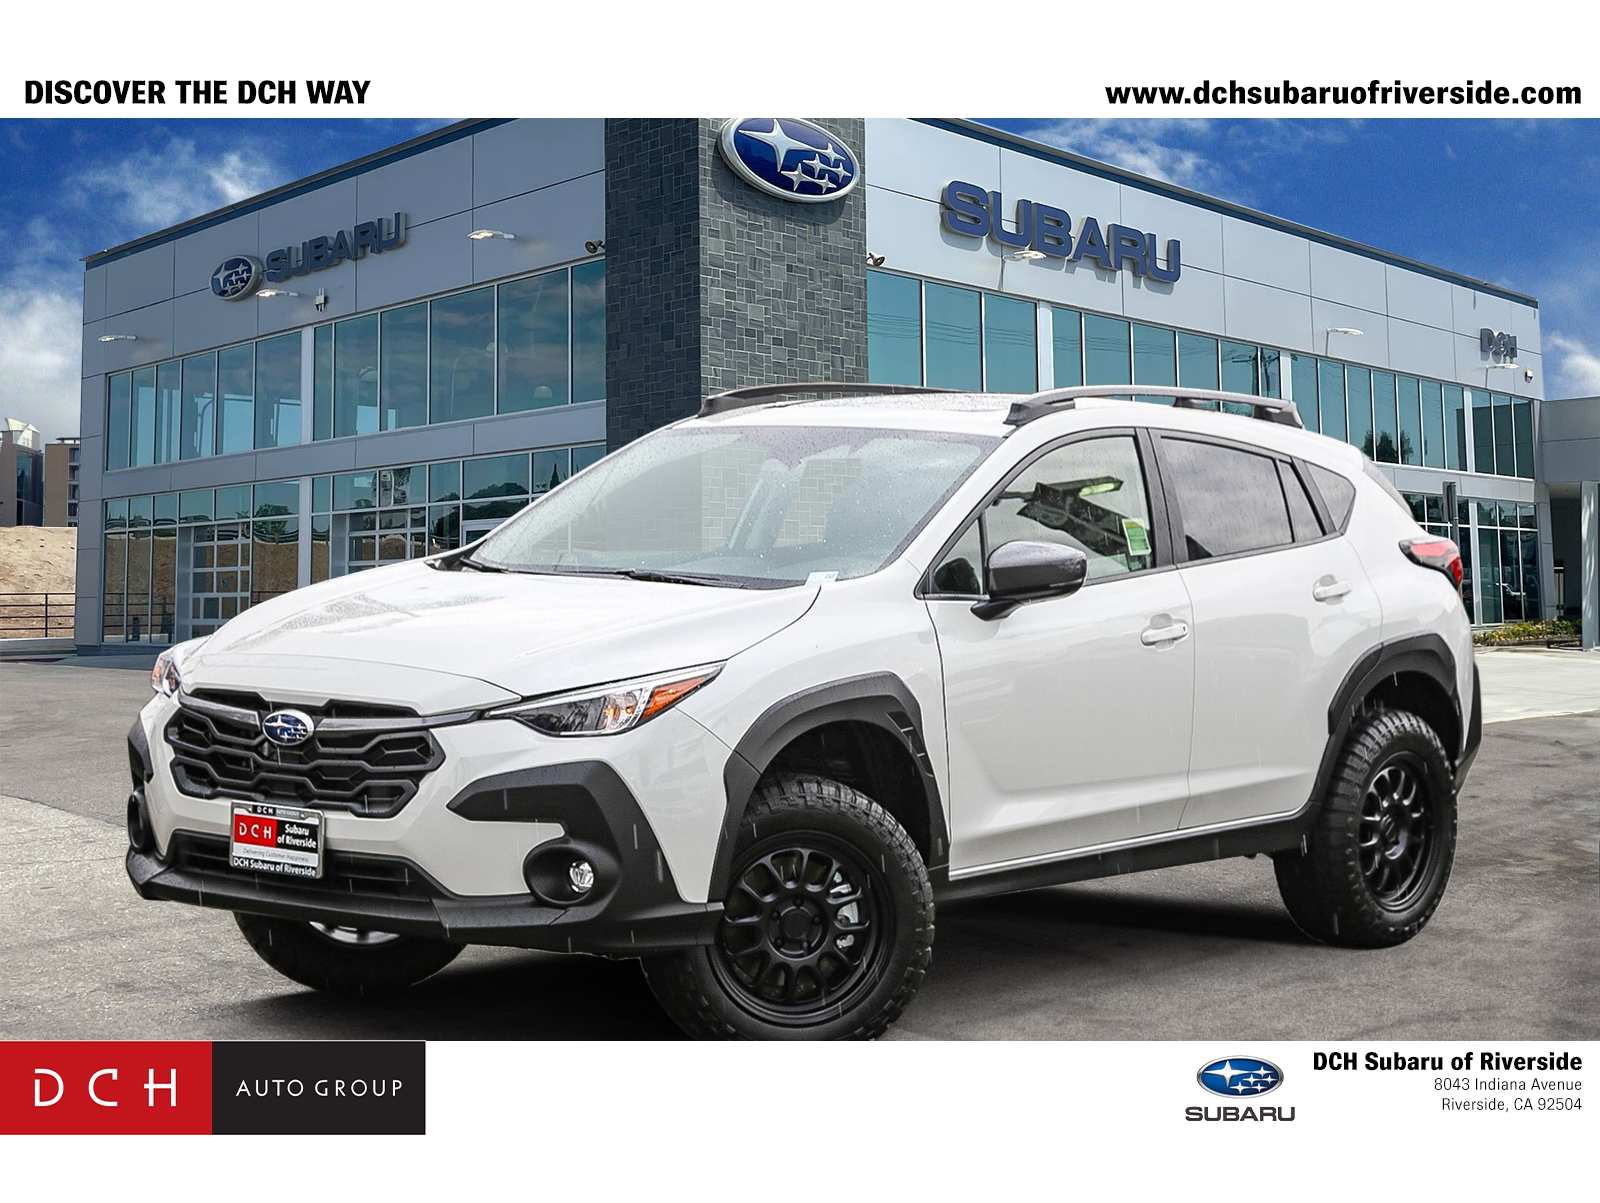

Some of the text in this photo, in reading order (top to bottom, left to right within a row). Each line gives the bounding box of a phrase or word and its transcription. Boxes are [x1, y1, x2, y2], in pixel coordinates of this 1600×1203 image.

[941, 180, 1181, 282] SUBARU
[265, 211, 406, 283] SUBARU
[239, 822, 272, 839] DCH
[285, 824, 309, 836] Subaru
[277, 835, 316, 848] of Riverside
[233, 857, 316, 877] DCH Subaru of Riverside
